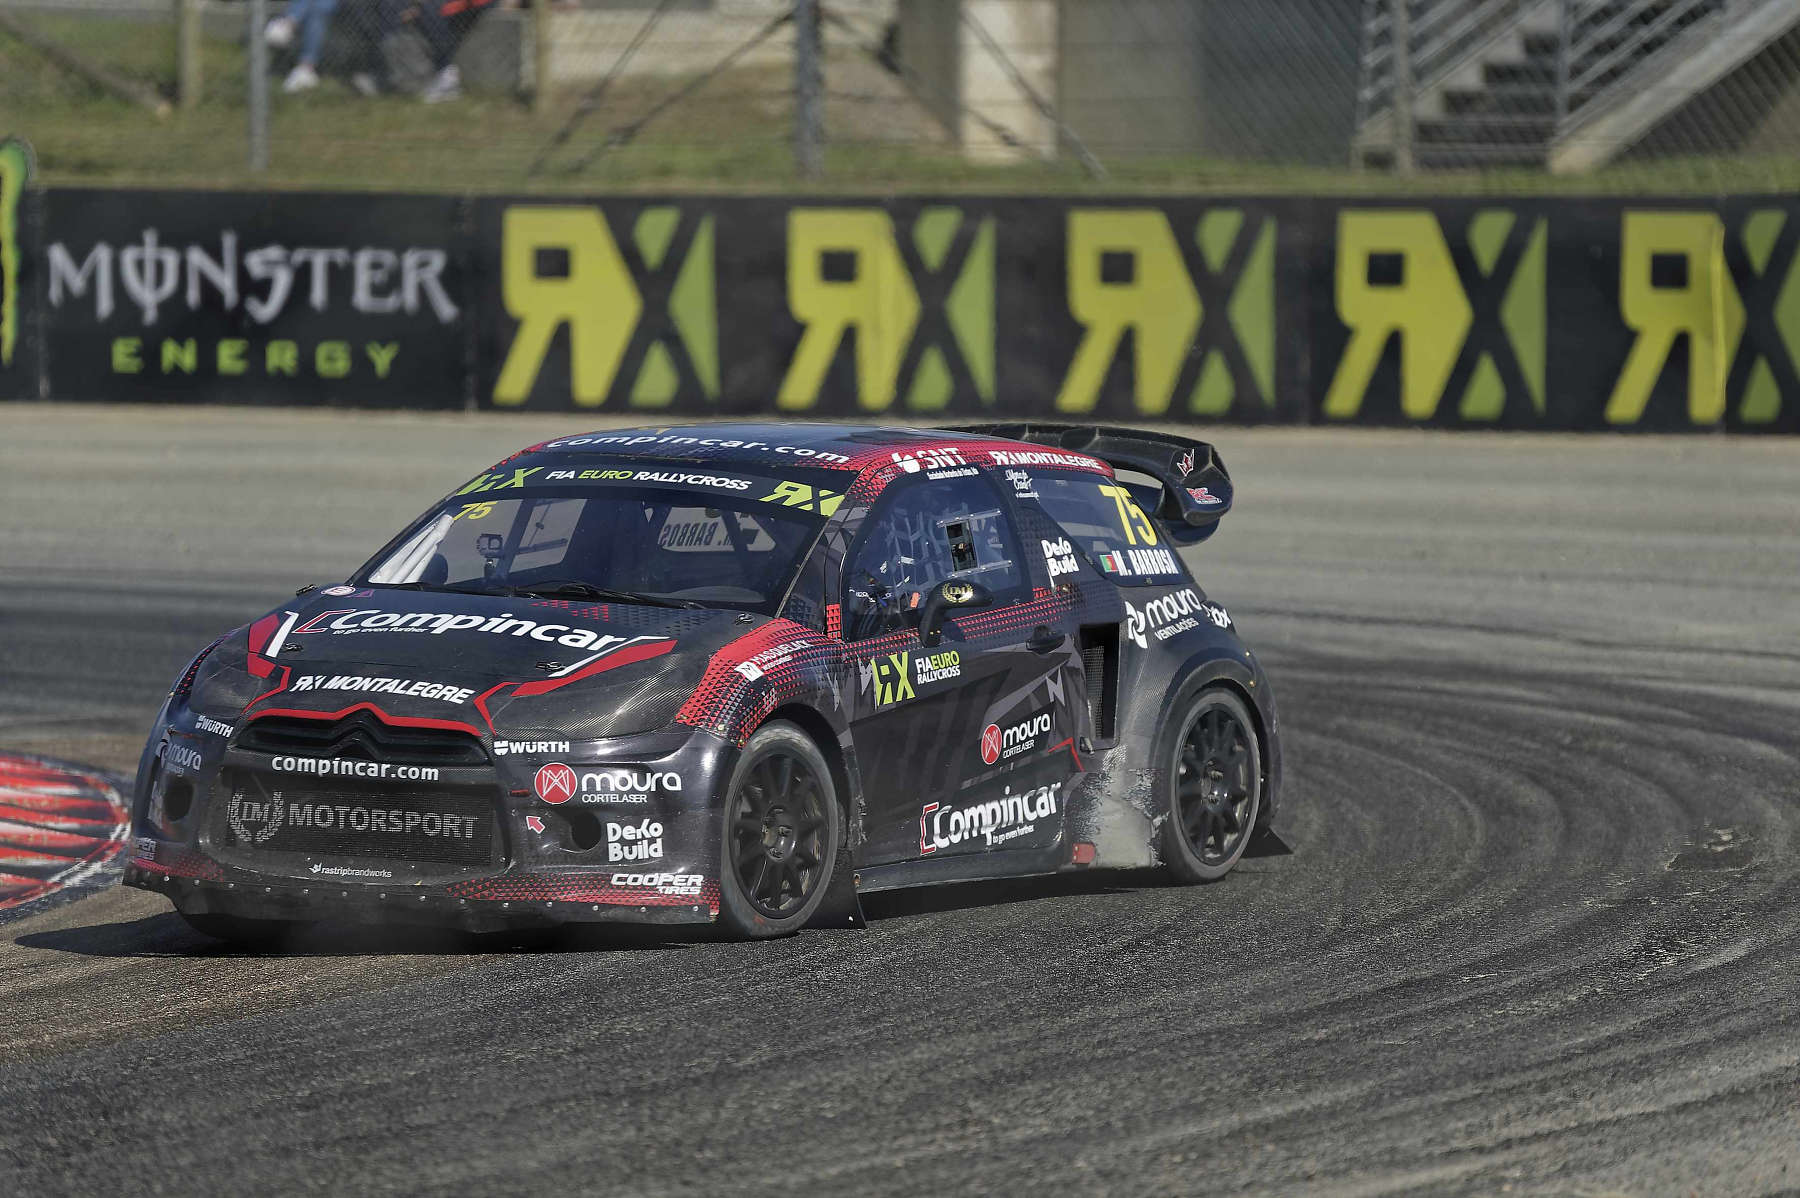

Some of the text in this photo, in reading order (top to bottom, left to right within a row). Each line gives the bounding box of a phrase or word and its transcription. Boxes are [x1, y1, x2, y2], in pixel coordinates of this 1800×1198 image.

[47, 229, 459, 325] MONSTER
[112, 338, 398, 377] ENERGY
[547, 434, 850, 464] compincar.com
[916, 447, 967, 469] SNT
[1014, 452, 1102, 470] MONTALEGRE
[545, 470, 752, 491] FIA EURO RALLYCROSS
[452, 501, 498, 520] 75
[1098, 485, 1158, 546] 75
[1047, 555, 1079, 577] Build
[1128, 549, 1178, 576] BARBOSA
[1146, 589, 1202, 628] moura
[330, 609, 627, 651] Compincar
[917, 665, 960, 685] RALLYCROSS
[323, 675, 475, 704] MONTALEGRE
[1003, 713, 1050, 748] moura
[1003, 740, 1035, 759] CORTELASER
[271, 755, 439, 781] compincar.com
[581, 772, 682, 792] moura
[582, 794, 647, 803] CORTELASER
[289, 803, 479, 838] MOTORSPORT
[933, 782, 1061, 848] Compincar
[608, 838, 663, 861] Build
[611, 873, 704, 886] COOPER
[656, 886, 702, 895] TIRES
